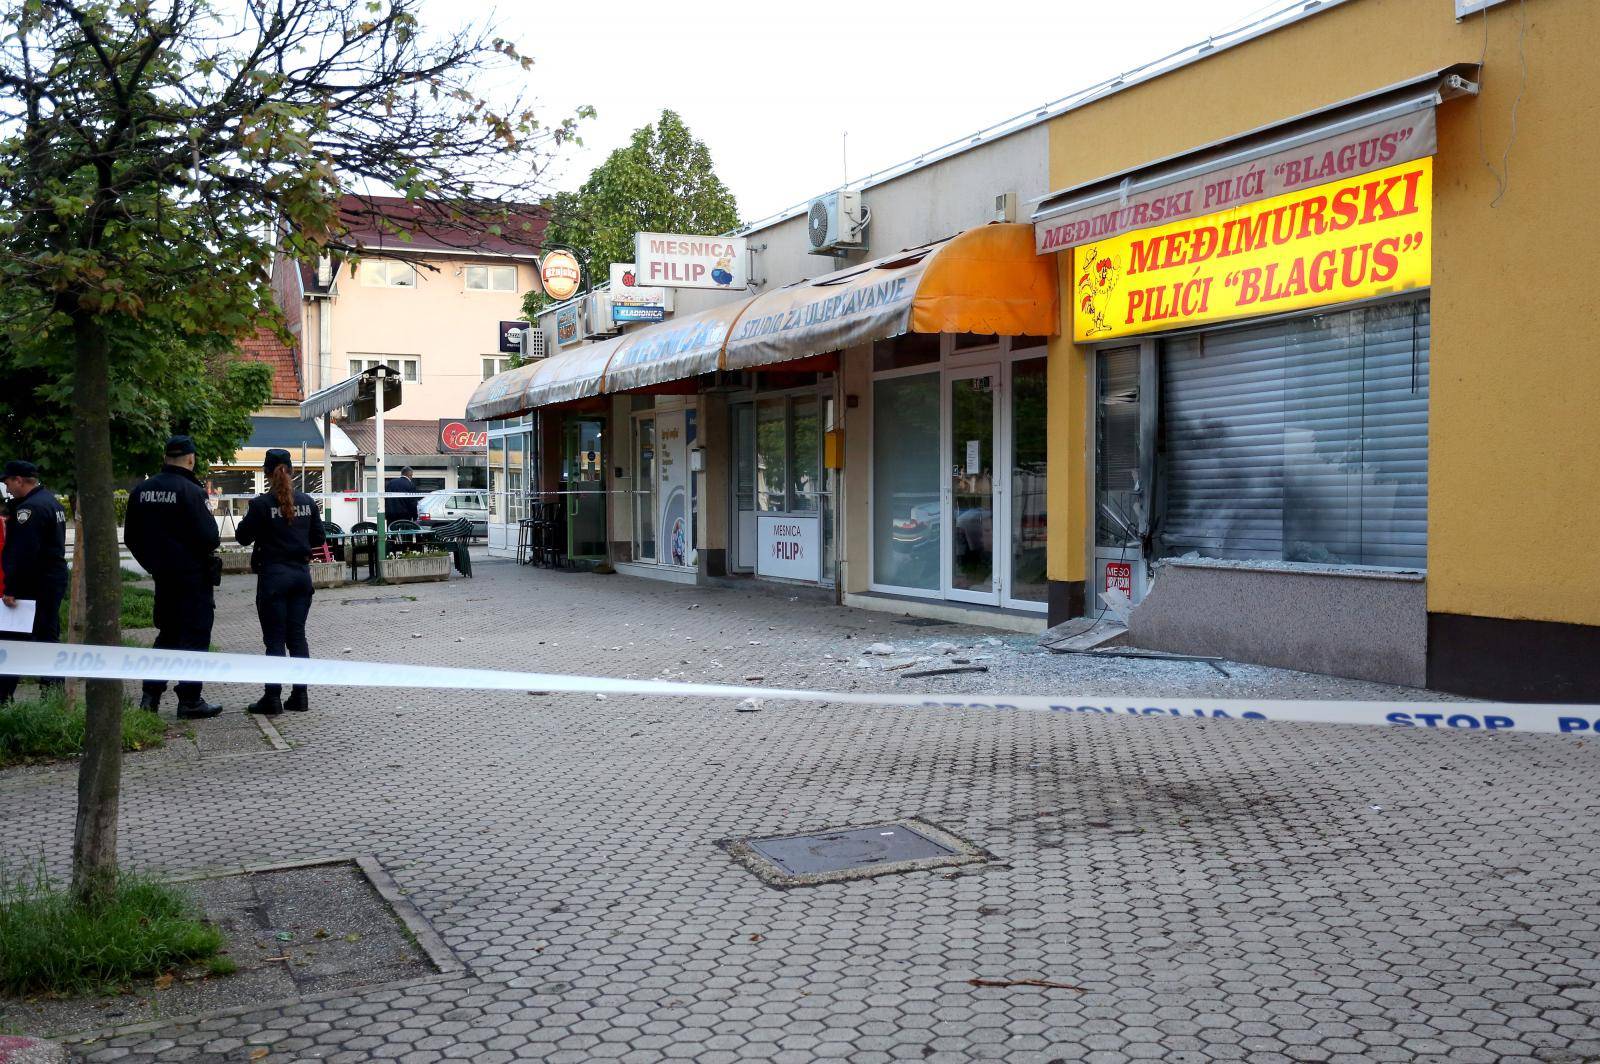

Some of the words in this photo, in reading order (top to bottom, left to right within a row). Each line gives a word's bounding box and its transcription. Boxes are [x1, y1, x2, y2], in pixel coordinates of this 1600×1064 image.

[1042, 190, 1194, 249] MEĐIMURSKI
[1202, 164, 1266, 210] PILIĆI
[1126, 170, 1423, 275] MEĐIMURSKI
[650, 239, 736, 258] MESNICA
[650, 261, 705, 281] FILIP
[1125, 269, 1213, 325] PILIĆI
[619, 309, 663, 317] KLADIONICA
[271, 504, 312, 519] POCIJA
[773, 525, 802, 537] MESNICA
[776, 541, 799, 560] FILIP
[1107, 567, 1130, 577] MESO
[1386, 711, 1515, 730] STOP
[1558, 716, 1600, 734] P
